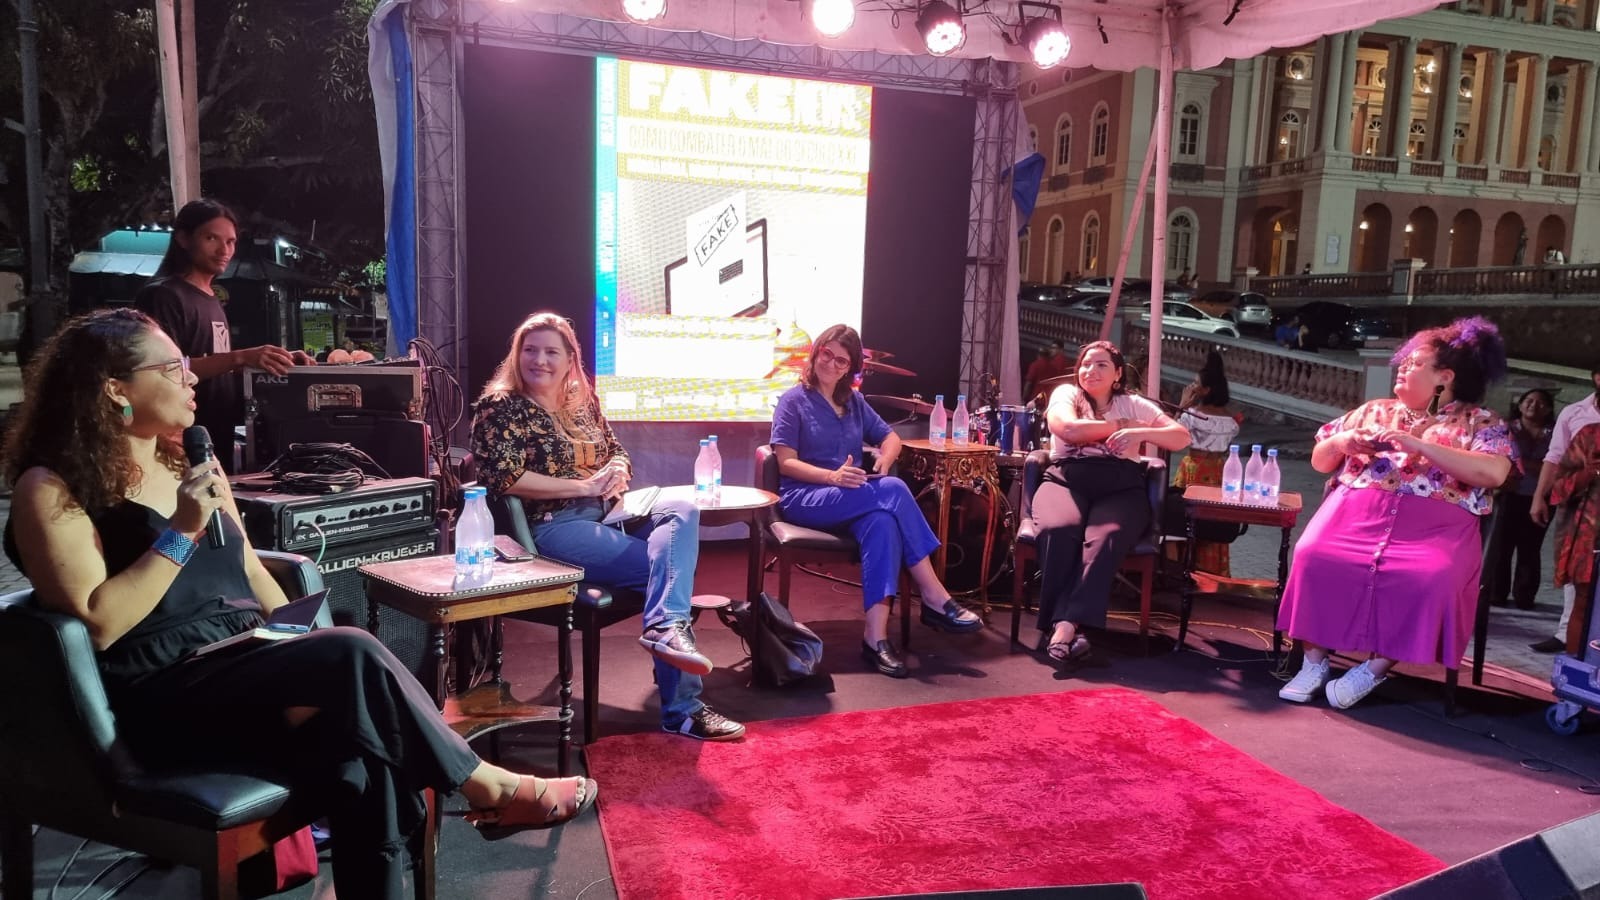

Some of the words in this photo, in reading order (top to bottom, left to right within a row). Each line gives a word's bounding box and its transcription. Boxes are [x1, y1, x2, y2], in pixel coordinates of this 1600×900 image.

[629, 62, 792, 122] FAKE
[701, 213, 733, 256] FAKE
[256, 374, 289, 384] AKG
[309, 524, 369, 538] GALIEN-KRUEGER
[316, 541, 436, 575] ALLIEN-KRUEGER
